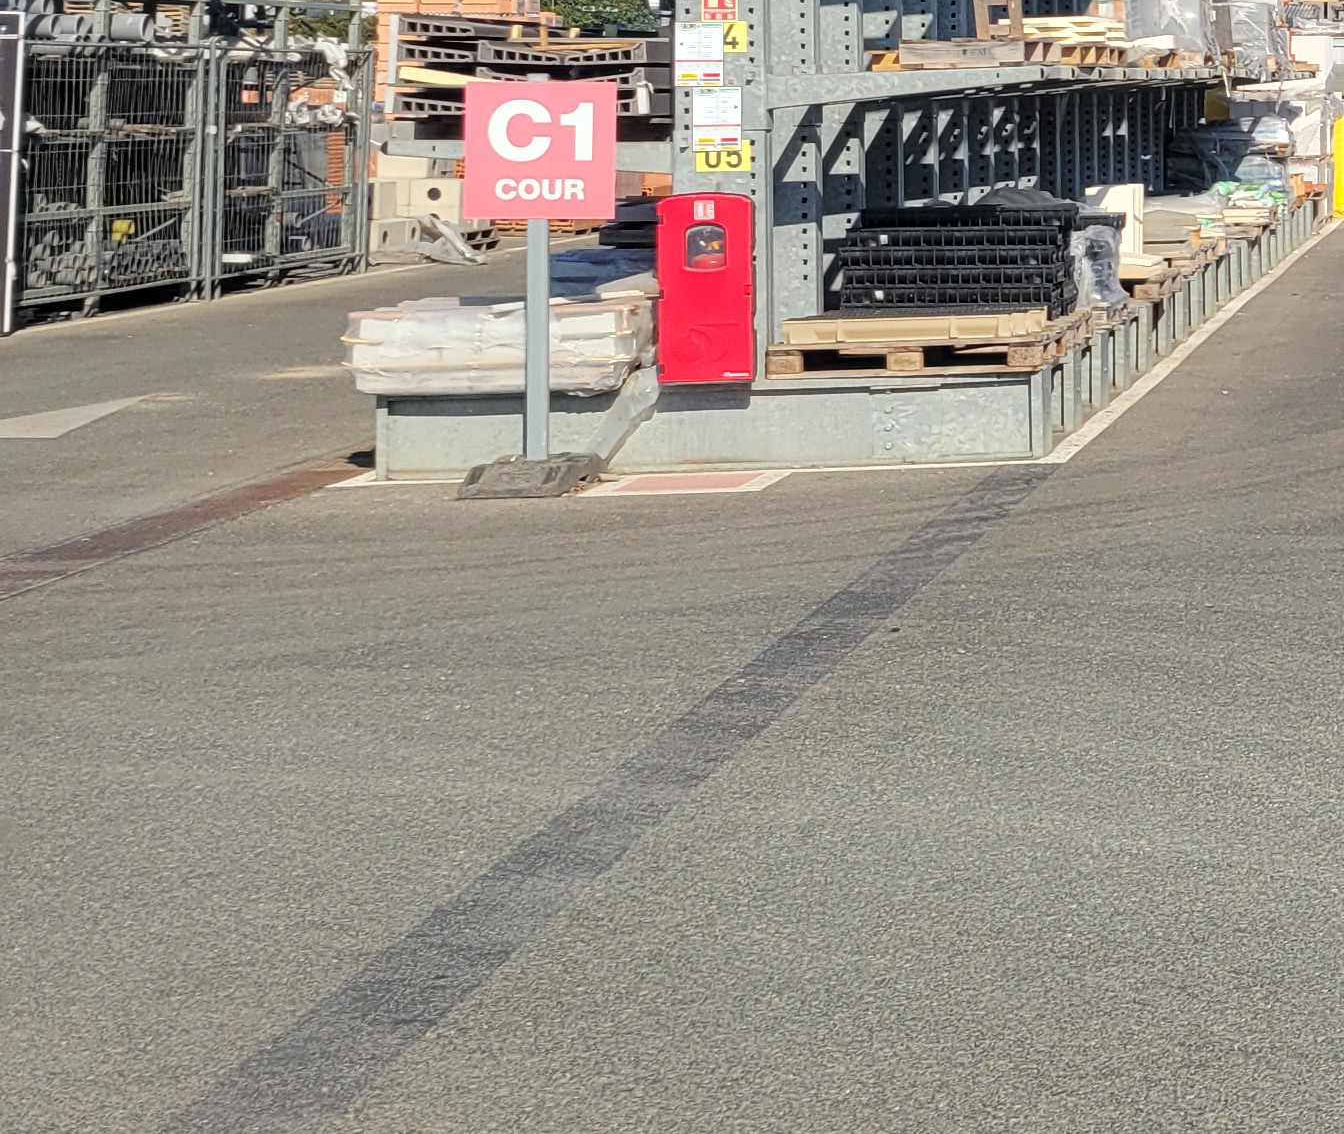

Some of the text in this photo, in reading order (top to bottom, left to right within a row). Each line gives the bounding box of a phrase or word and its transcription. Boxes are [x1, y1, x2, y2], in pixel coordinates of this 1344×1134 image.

[724, 24, 740, 50] 4
[488, 99, 594, 162] C1
[495, 178, 585, 200] COUR
